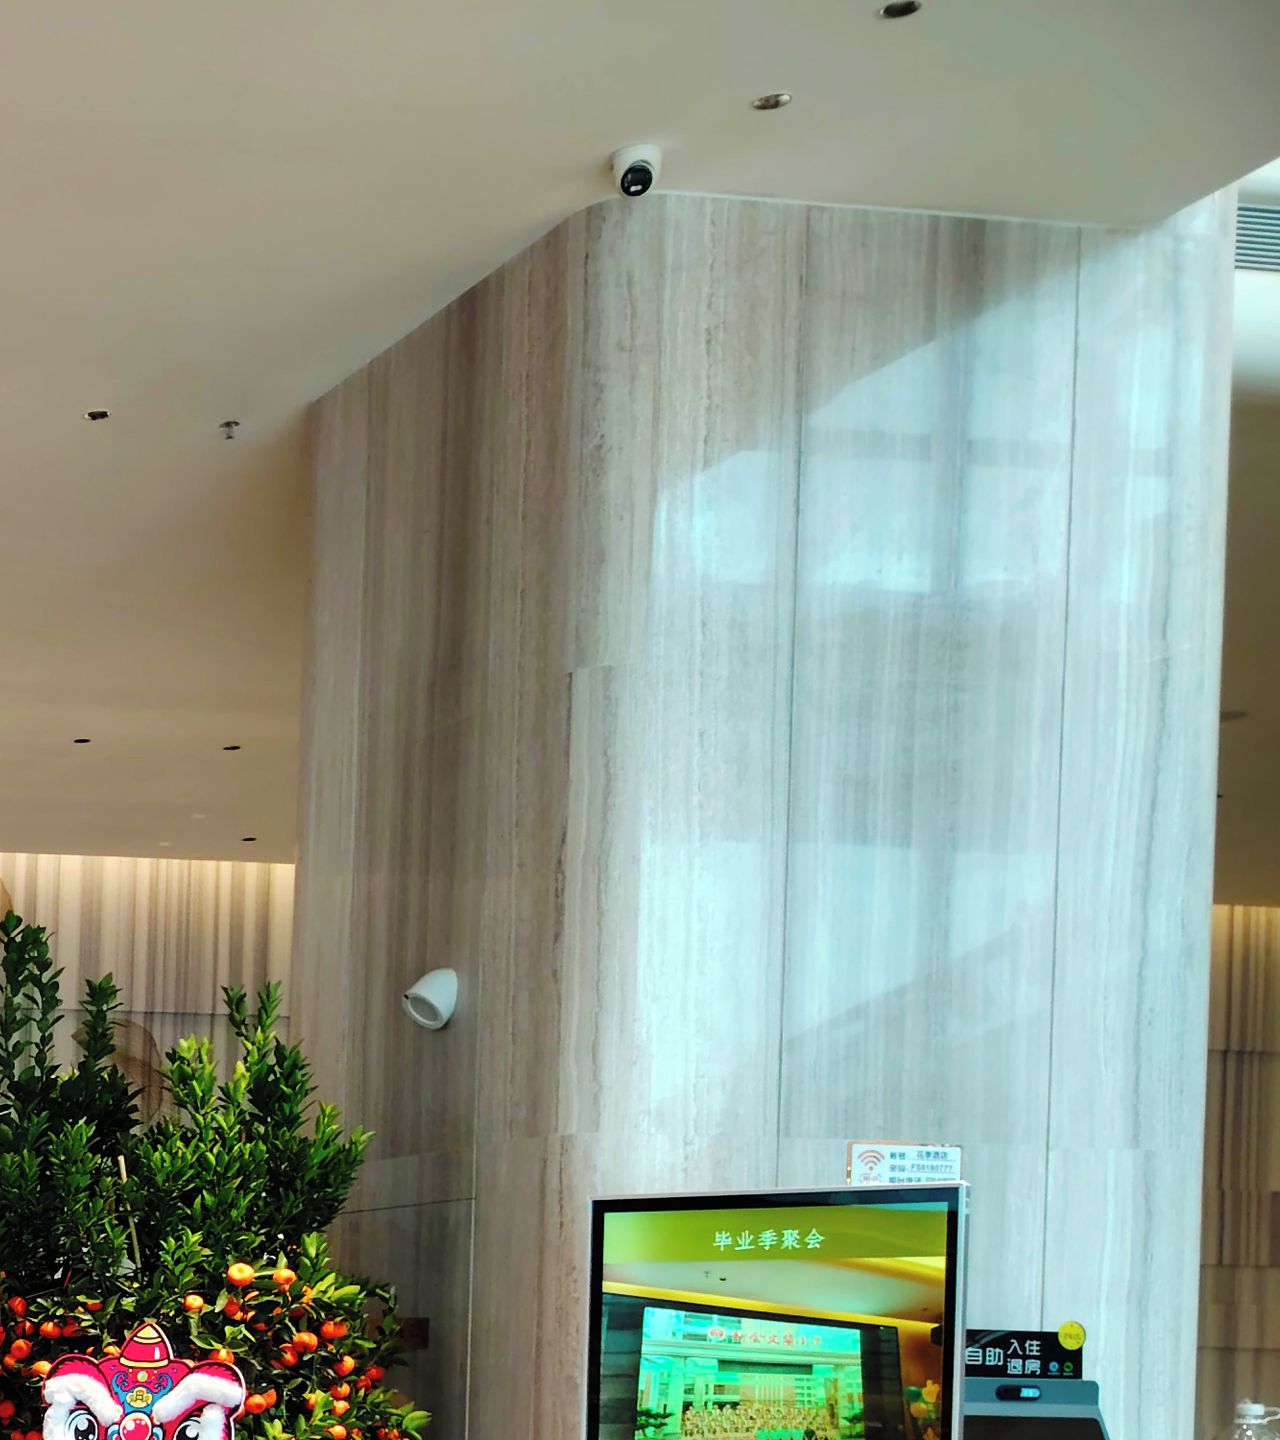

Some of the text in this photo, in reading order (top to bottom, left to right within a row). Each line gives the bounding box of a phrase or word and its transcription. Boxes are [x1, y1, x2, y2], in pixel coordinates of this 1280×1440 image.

[713, 1228, 826, 1251] 毕业季聚会
[965, 1346, 1004, 1366] 自助
[1007, 1339, 1042, 1356] 入住
[1007, 1358, 1042, 1375] 退房
